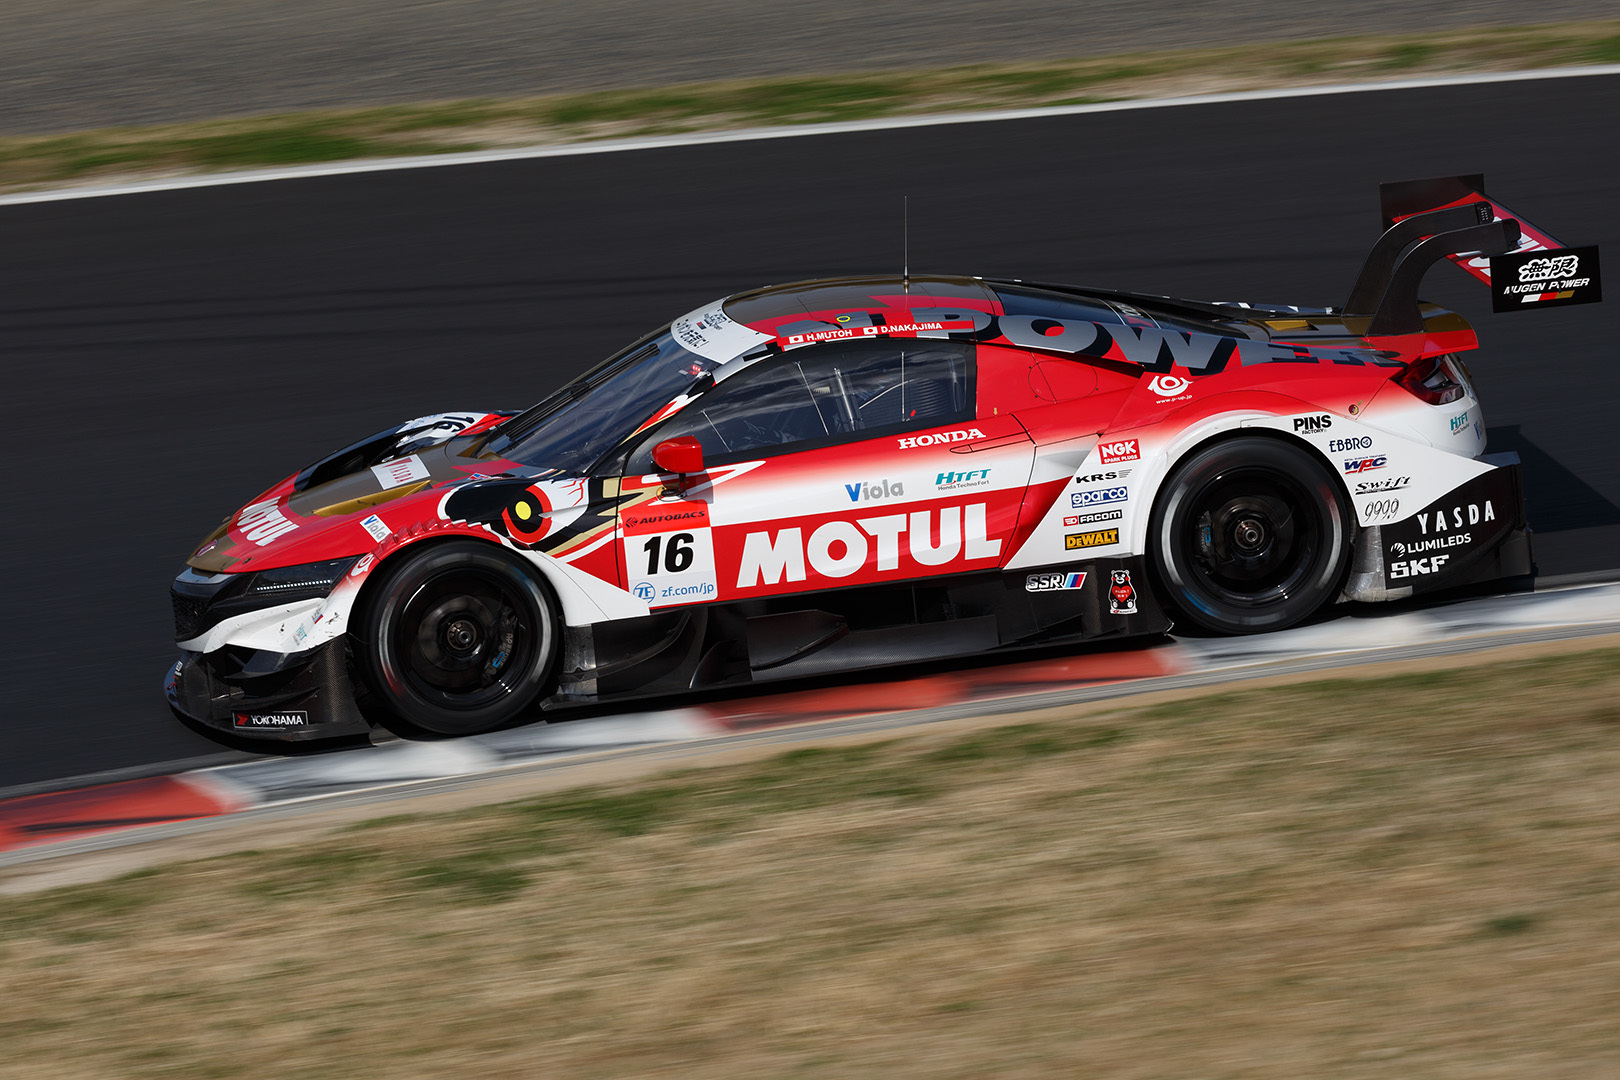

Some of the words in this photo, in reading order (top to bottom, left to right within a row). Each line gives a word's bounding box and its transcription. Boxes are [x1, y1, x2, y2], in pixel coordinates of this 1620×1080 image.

[1504, 282, 1546, 295] MUGEN
[1548, 278, 1590, 290] POWER
[806, 329, 853, 342] H.MUTOH
[880, 321, 943, 334] D.NAKAJIMA
[909, 307, 1402, 370] POWER
[1293, 414, 1332, 432] PINS
[897, 428, 987, 450] HONDA
[1329, 436, 1373, 453] EBBRO
[1101, 440, 1137, 458] NGK
[936, 468, 992, 485] HTFT
[1076, 471, 1118, 484] KRS
[844, 479, 905, 503] Viola
[1072, 487, 1127, 506] sparco
[640, 511, 706, 525] AUTOBACS
[1080, 510, 1121, 523] FACOM
[1417, 500, 1496, 535] YASDA
[736, 502, 1003, 588] MOTUL
[1407, 533, 1472, 554] LUMILEDS
[643, 532, 695, 575] 16
[1390, 554, 1450, 579] SKF
[662, 582, 714, 598] zf.com/jp
[1026, 573, 1063, 590] SSR
[250, 715, 304, 725] YOKOHAMA
